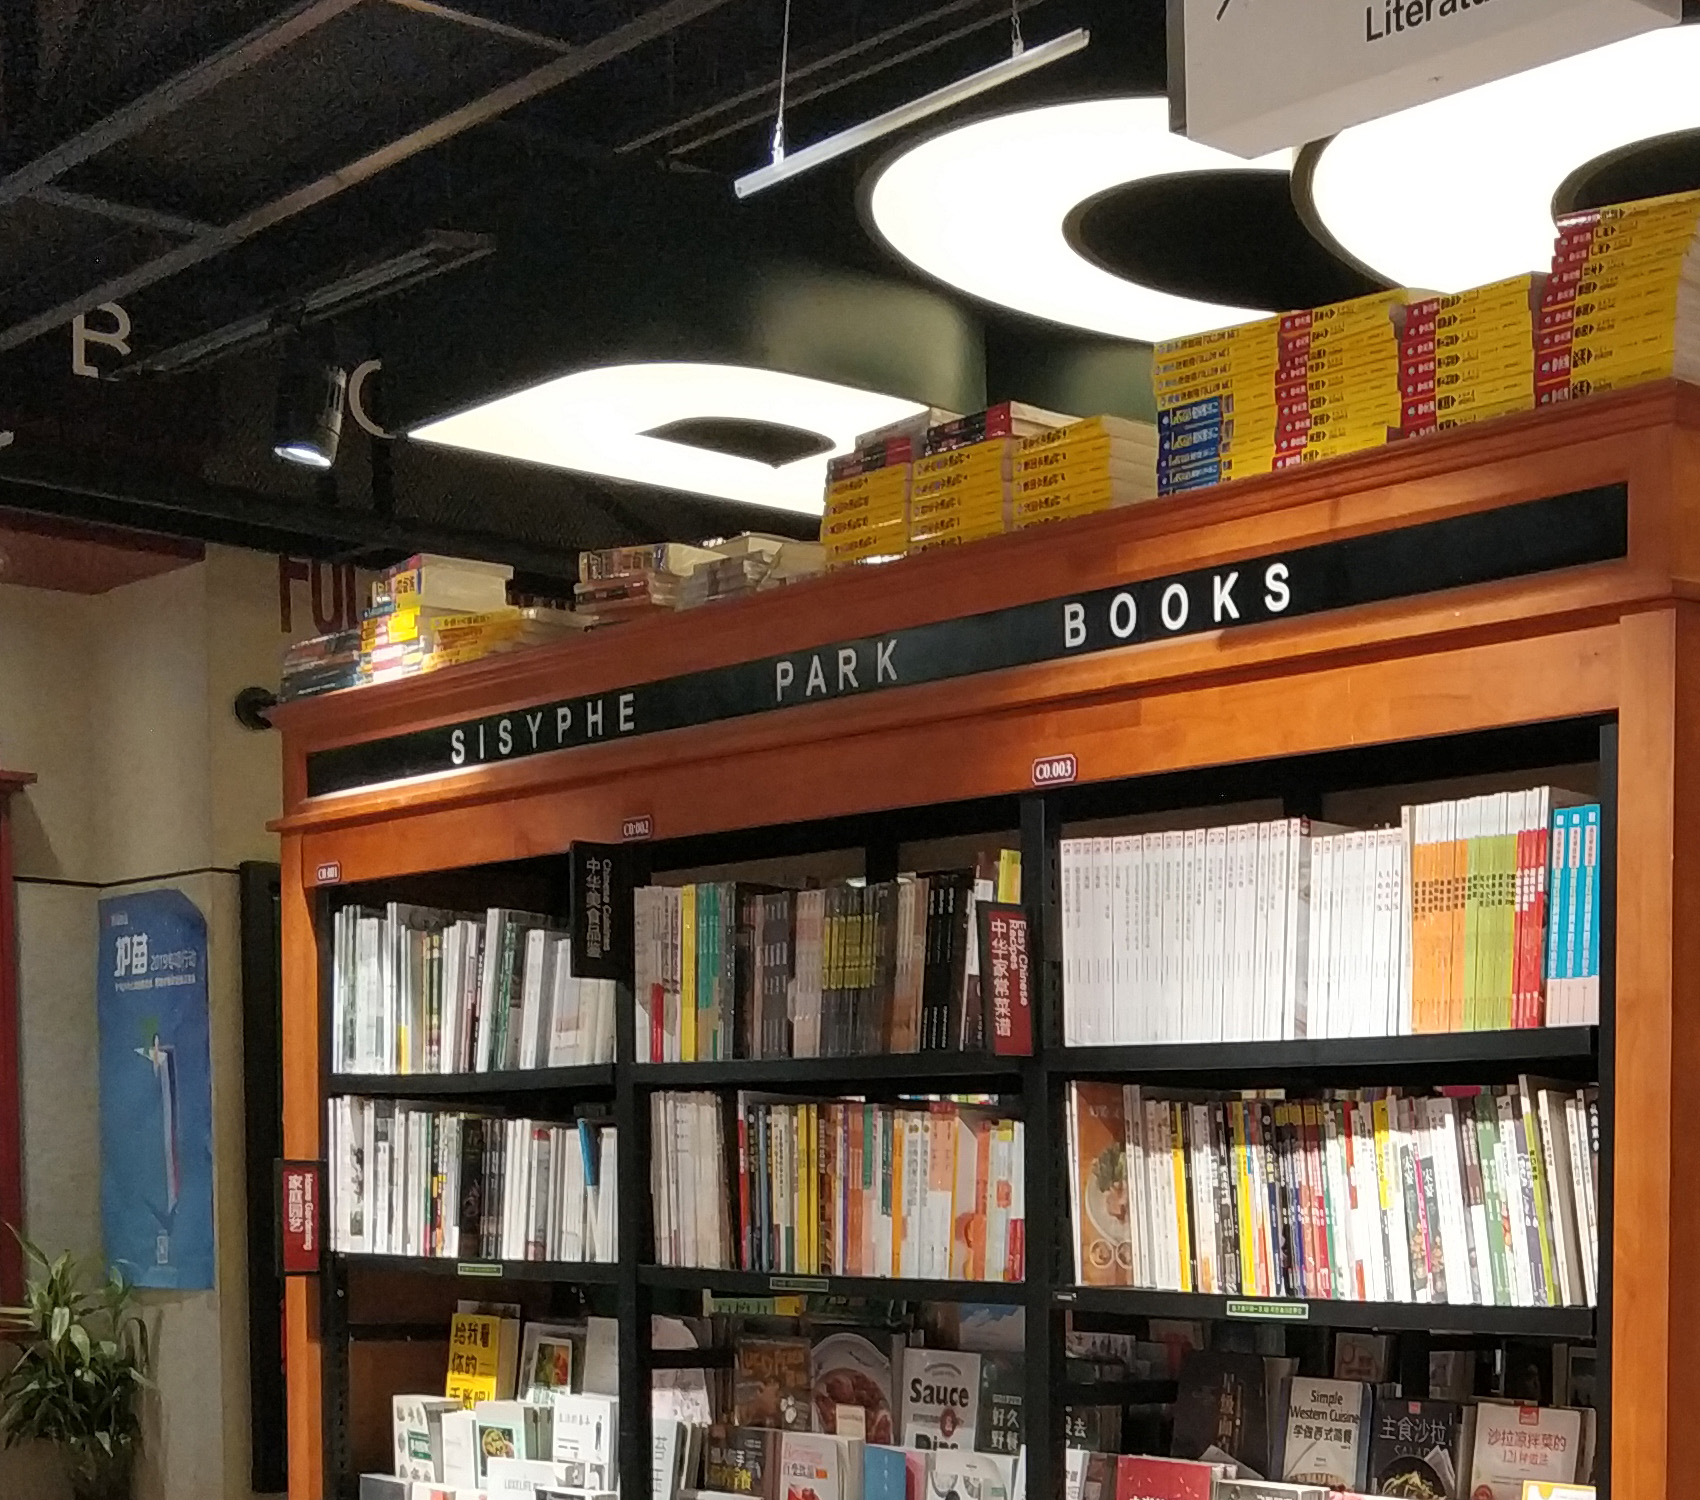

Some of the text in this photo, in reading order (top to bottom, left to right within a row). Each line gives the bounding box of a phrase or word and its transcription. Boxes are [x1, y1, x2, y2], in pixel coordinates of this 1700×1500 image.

[1366, 0, 1490, 42] Litera
[450, 563, 1291, 766] SISYPHE PARK BOOKS
[1008, 919, 1018, 971] Recipes
[1017, 919, 1029, 1006] Easy Chinese
[909, 1377, 970, 1408] Sauce
[1310, 1389, 1344, 1407] Simple
[1290, 1405, 1361, 1425] Western Cuisine
[1380, 1416, 1447, 1446] 主食沙拉
